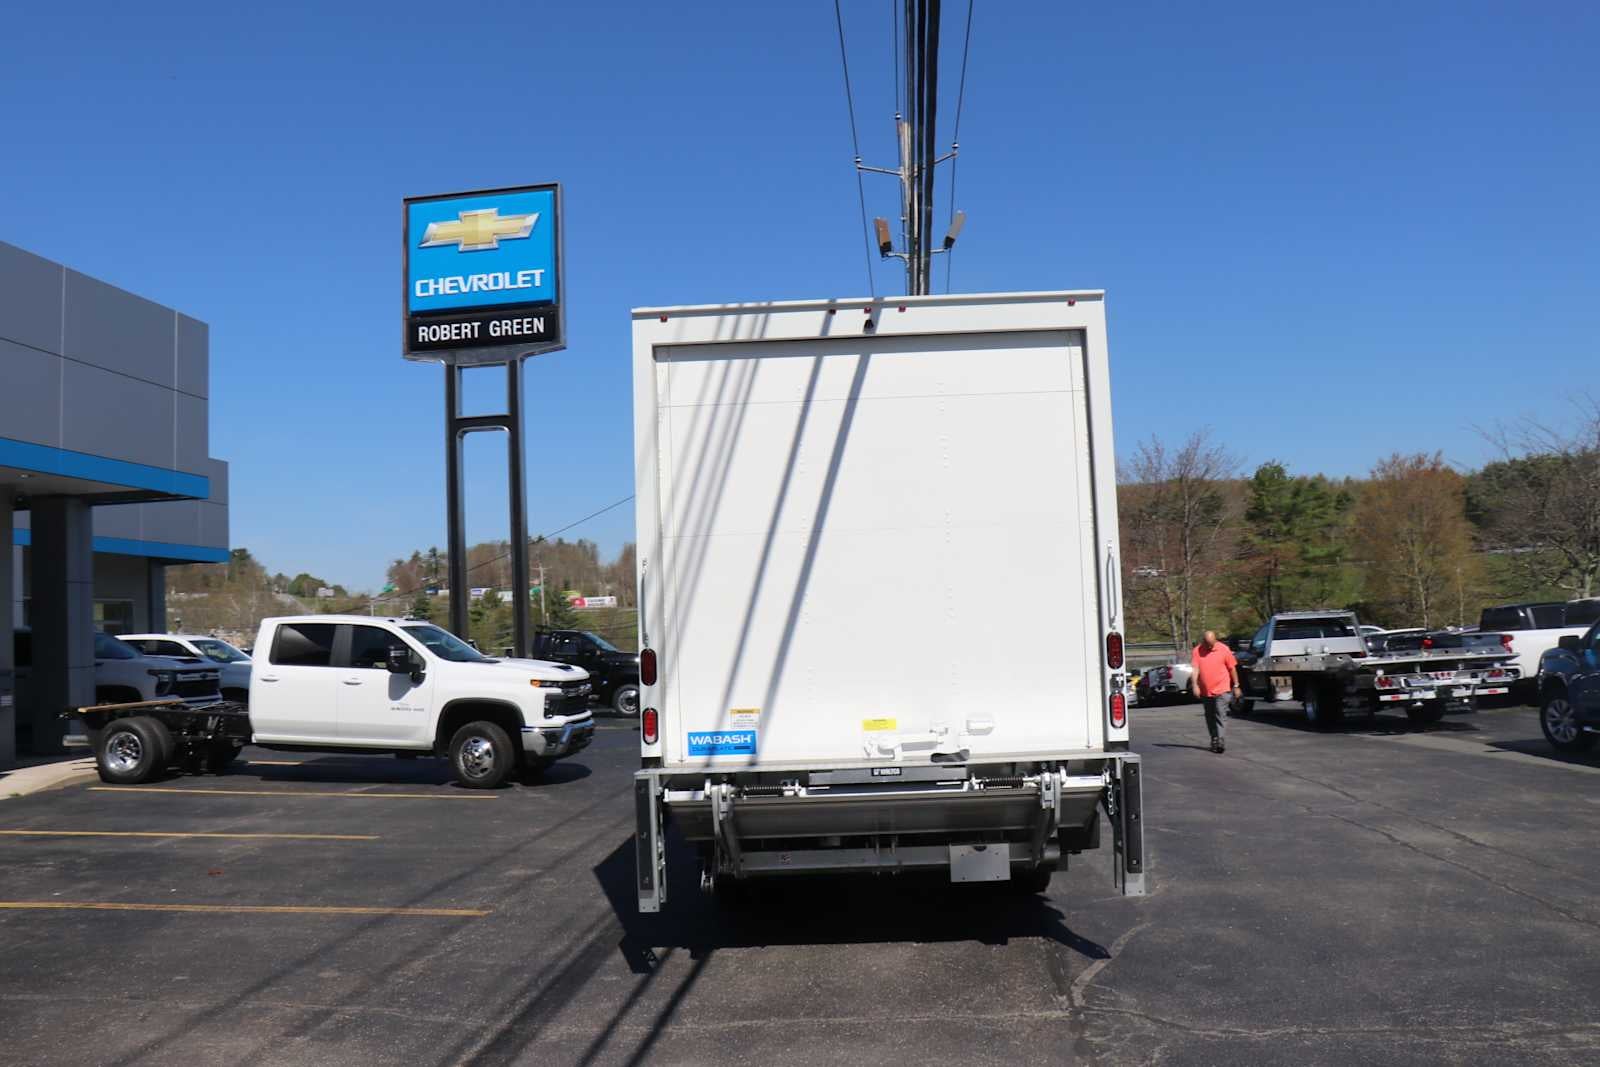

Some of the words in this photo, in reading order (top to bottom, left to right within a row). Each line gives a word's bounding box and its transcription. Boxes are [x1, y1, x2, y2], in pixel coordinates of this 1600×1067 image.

[415, 269, 545, 297] CHEVROLET
[418, 321, 481, 343] ROBERT
[489, 317, 545, 337] GREEN
[690, 734, 752, 745] WABASH
